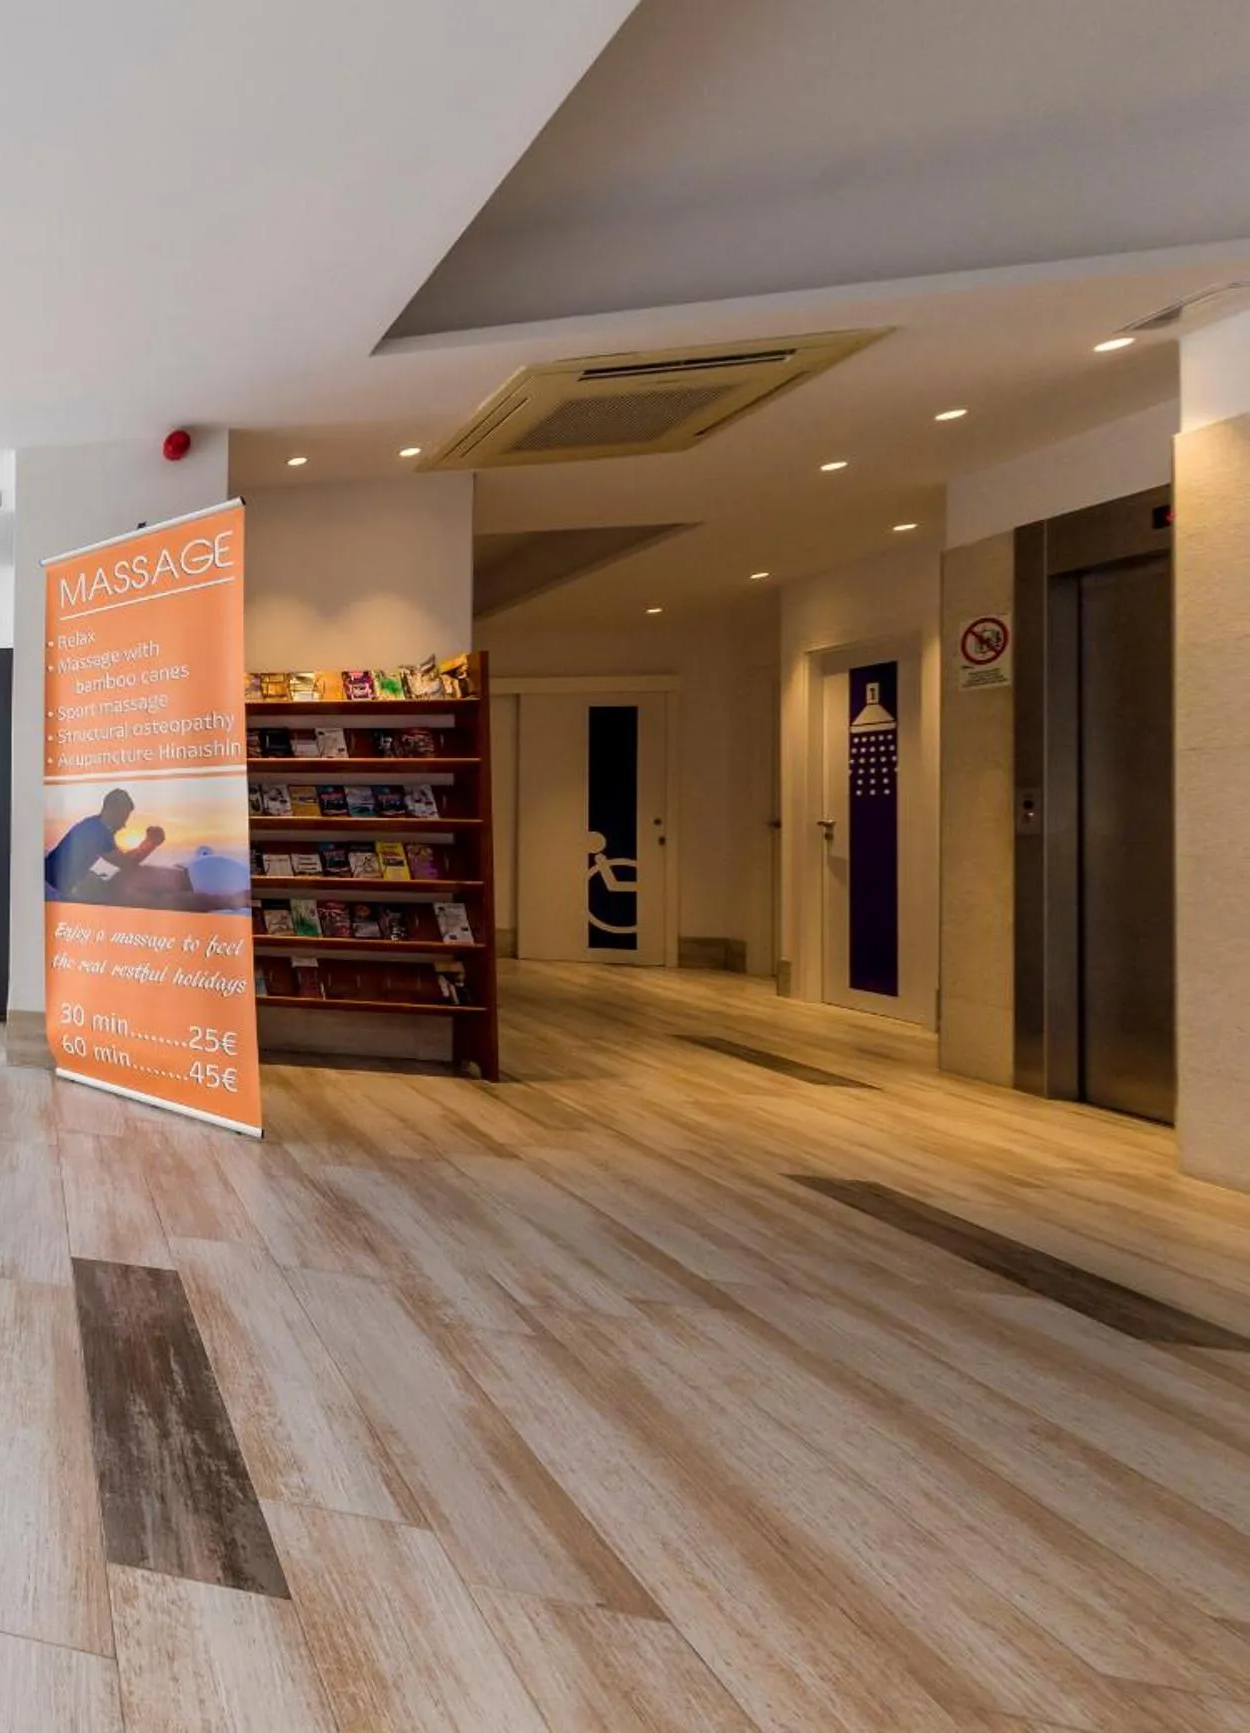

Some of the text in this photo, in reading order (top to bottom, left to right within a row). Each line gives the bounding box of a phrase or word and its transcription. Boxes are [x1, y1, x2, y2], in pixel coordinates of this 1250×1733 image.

[59, 530, 234, 608] MASSAGE
[57, 630, 96, 650] Relax
[57, 640, 160, 675] Massage with
[75, 664, 190, 695] bamboo canes
[57, 693, 168, 721] Sport massage
[57, 710, 235, 744] Structural osteopathy
[57, 748, 153, 769] Acupuncture
[55, 922, 91, 945] Enjoy
[110, 931, 176, 952] massage
[182, 935, 200, 952] to
[205, 934, 245, 960] feel
[52, 951, 248, 998] the real restful holidays
[60, 1002, 85, 1027] 30
[62, 1034, 87, 1058] 60
